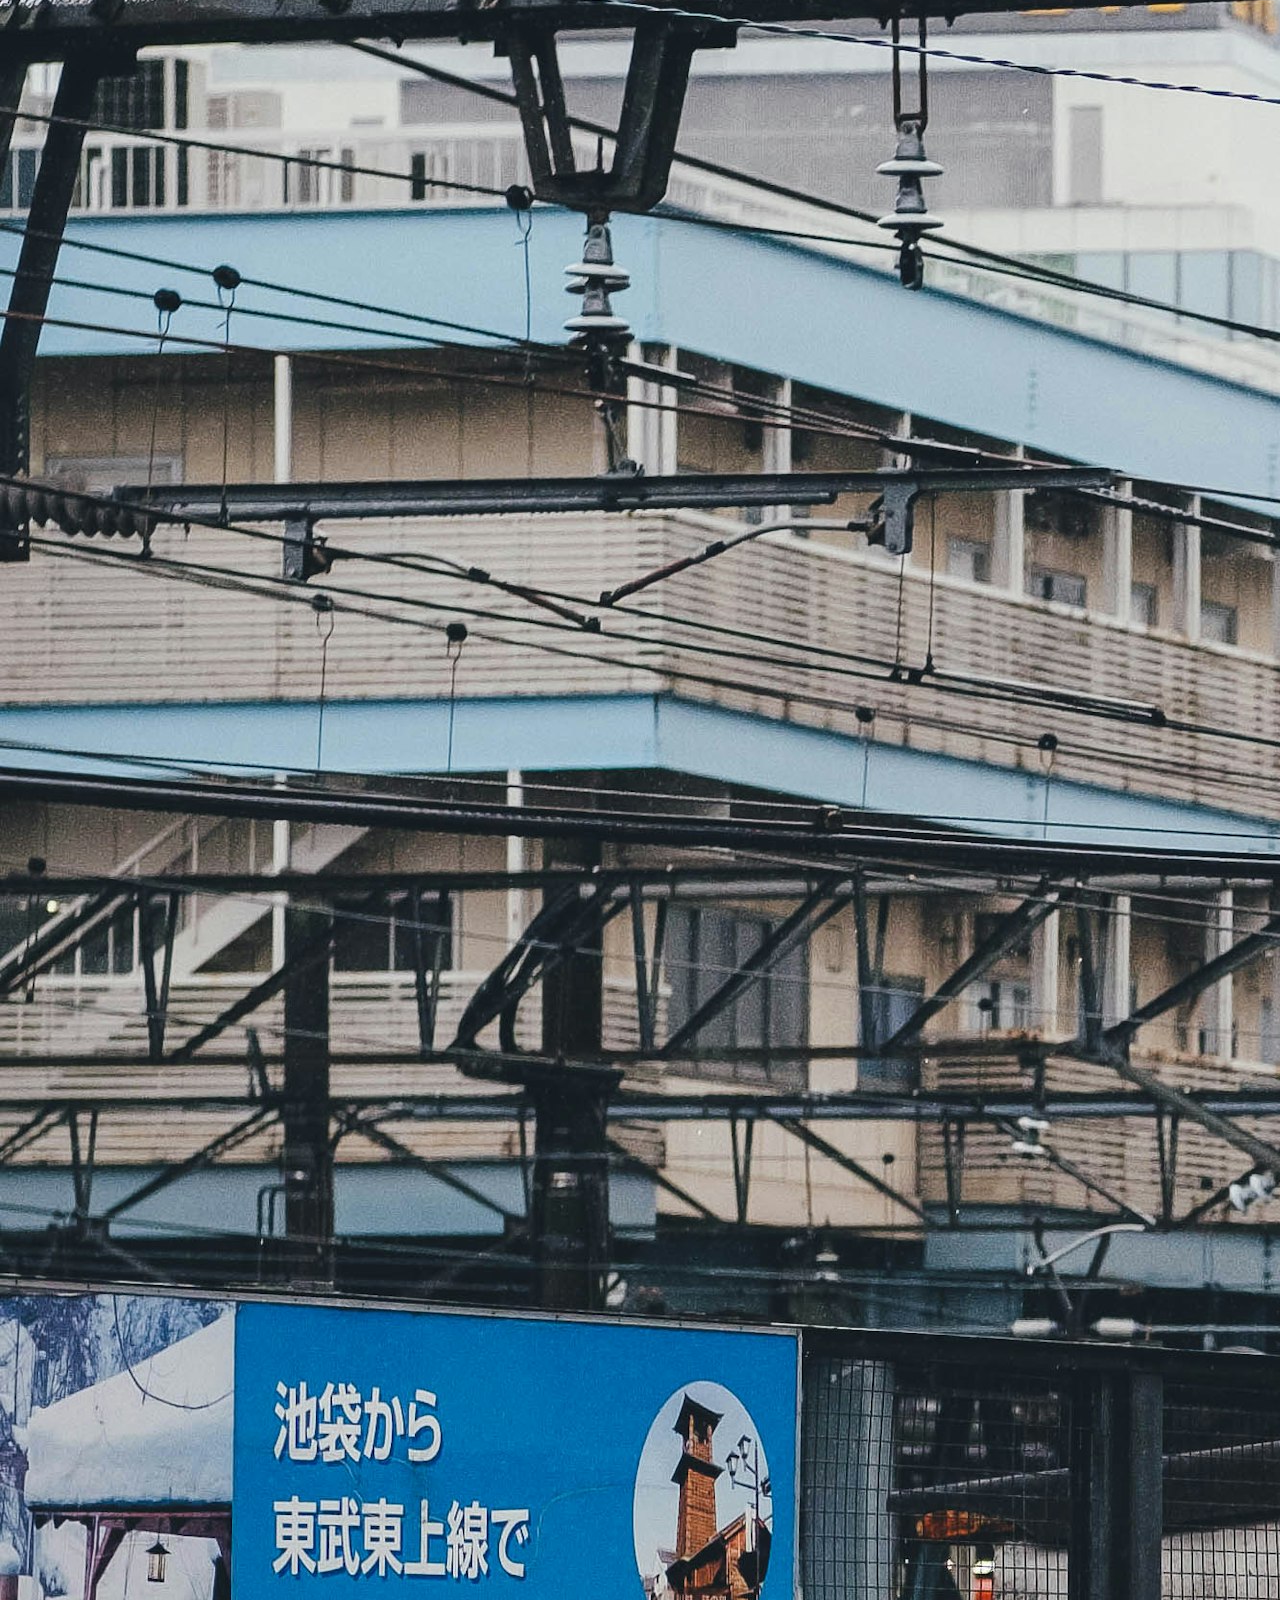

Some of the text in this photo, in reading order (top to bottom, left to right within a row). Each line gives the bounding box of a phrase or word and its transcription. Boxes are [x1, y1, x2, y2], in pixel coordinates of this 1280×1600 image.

[273, 1381, 442, 1462] 池袋から
[272, 1495, 530, 1579] 東武東上線で
